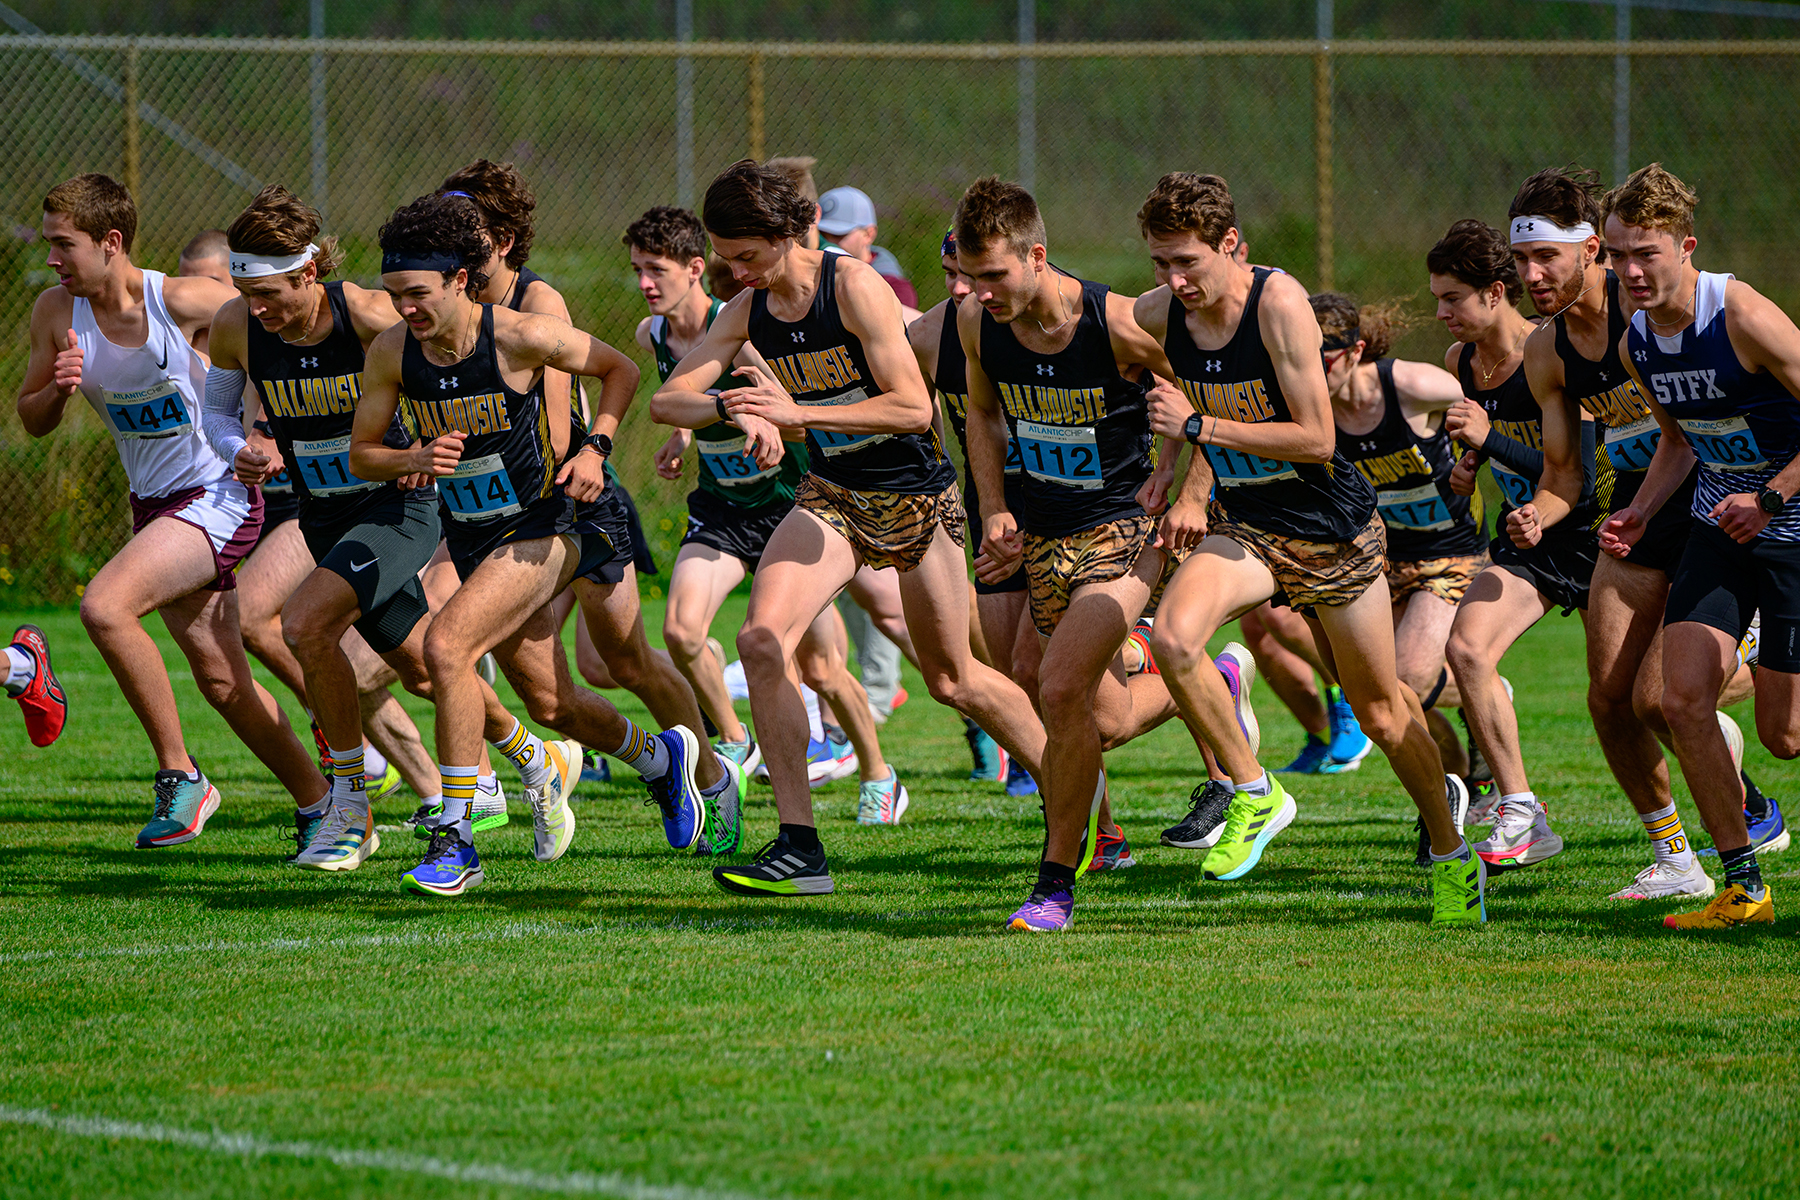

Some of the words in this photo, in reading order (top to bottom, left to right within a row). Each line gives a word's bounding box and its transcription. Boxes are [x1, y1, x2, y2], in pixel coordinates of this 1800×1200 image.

[766, 345, 861, 395] DALHOUSIE
[1651, 368, 1727, 404] STFX
[116, 397, 184, 430] 144
[411, 392, 512, 438] DALHOUSIE
[998, 382, 1108, 426] DALHOUSIE
[711, 452, 760, 477] 13
[1028, 442, 1096, 477] 112
[1354, 443, 1433, 487] LHOUSIE
[1697, 435, 1757, 464] 103
[307, 456, 349, 486] 11
[446, 474, 510, 510] 114
[1384, 500, 1437, 525] 117
[513, 743, 535, 769] D
[1665, 834, 1687, 855] D
